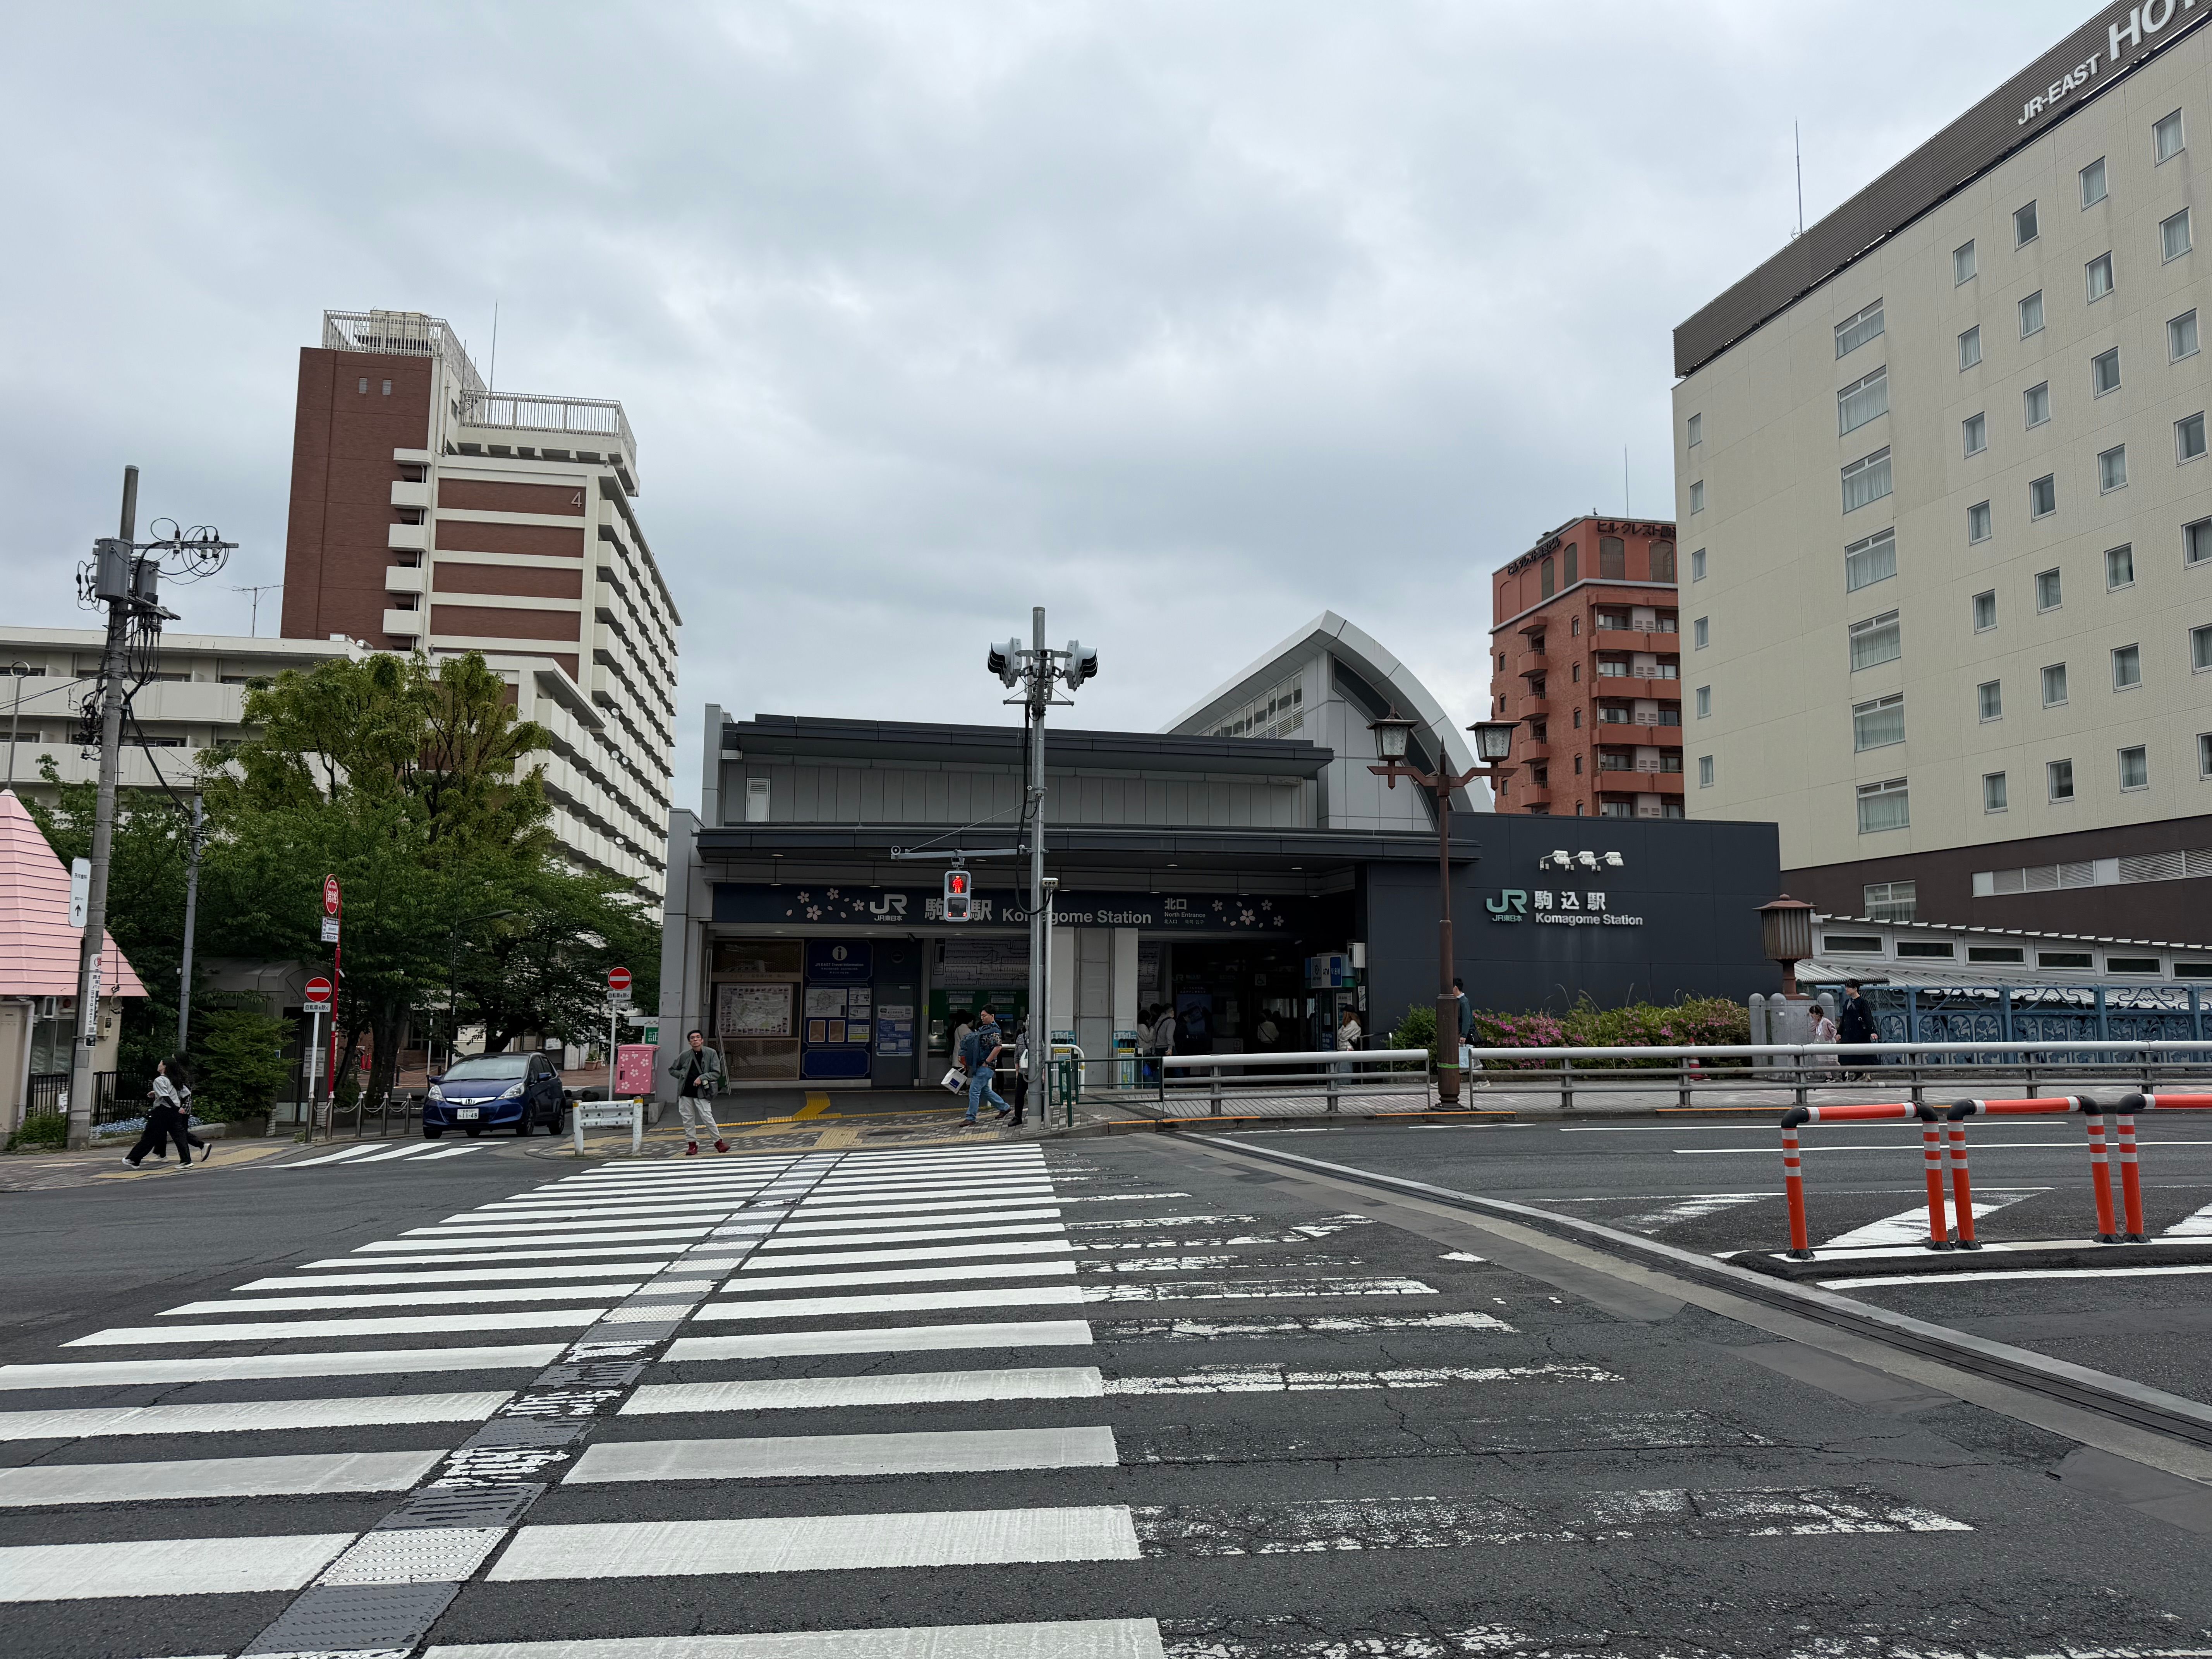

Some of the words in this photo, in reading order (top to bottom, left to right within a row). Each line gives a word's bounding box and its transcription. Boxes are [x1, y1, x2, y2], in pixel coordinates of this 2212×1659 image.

[2018, 52, 2102, 125] JR-EAST
[2109, 0, 2196, 62] HO
[571, 491, 582, 508] 4
[869, 894, 907, 914] JR
[925, 898, 992, 921] 駒駅
[1164, 898, 1187, 910] 北口
[1486, 889, 1527, 913] JR
[1534, 890, 1606, 911] 駒込駅
[1003, 908, 1093, 925] Kogome
[1097, 910, 1151, 924] Station
[1535, 912, 1600, 926] Komagome
[1603, 914, 1643, 925] Station
